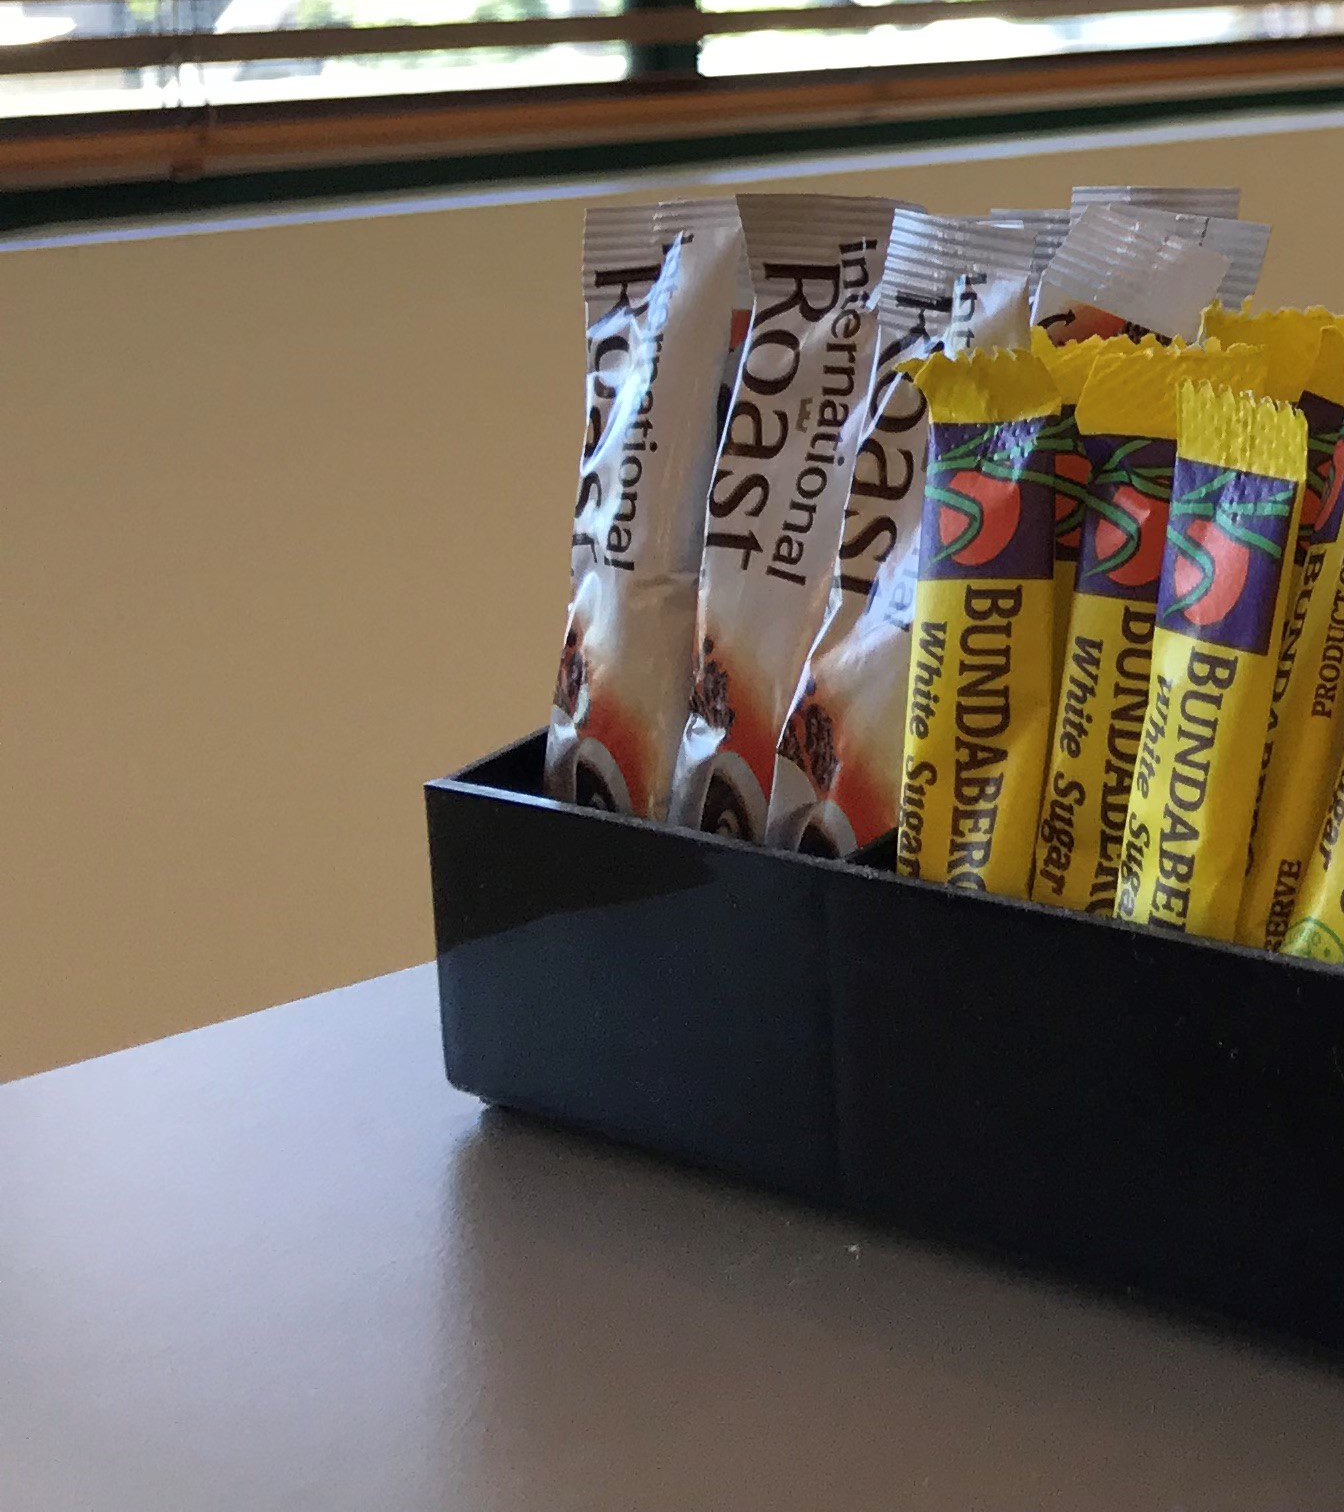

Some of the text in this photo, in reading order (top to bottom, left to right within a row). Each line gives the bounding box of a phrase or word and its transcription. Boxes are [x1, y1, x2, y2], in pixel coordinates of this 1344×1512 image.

[603, 233, 694, 572] Irational
[706, 262, 842, 571] Roast
[766, 238, 878, 587] International
[898, 620, 948, 879] White Sugar
[1039, 635, 1104, 897] White Sugar
[1117, 674, 1173, 920] White Suga
